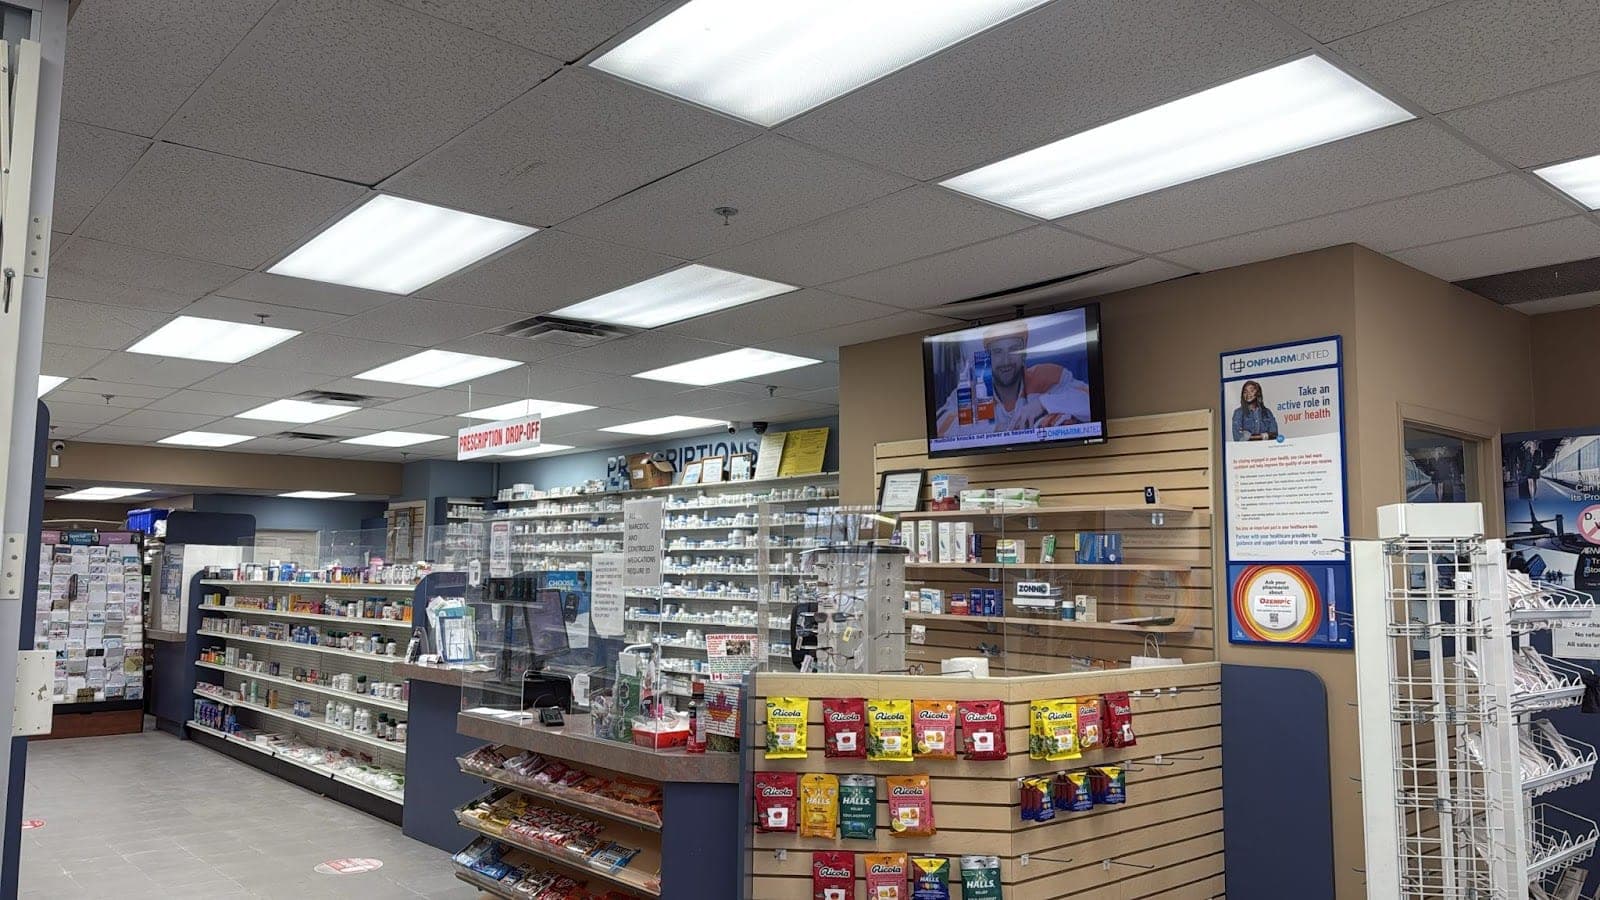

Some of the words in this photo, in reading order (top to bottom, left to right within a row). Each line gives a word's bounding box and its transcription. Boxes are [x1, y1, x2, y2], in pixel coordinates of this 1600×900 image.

[1246, 349, 1330, 368] ONPHARMUNITED
[1298, 386, 1317, 397] Take
[1319, 386, 1330, 394] an
[1277, 401, 1301, 411] active
[1303, 398, 1320, 408] role
[1322, 397, 1330, 406] in
[1284, 413, 1302, 424] your
[1304, 408, 1331, 420] health
[460, 428, 504, 452] PRESCRIPTION
[506, 421, 540, 445] DROP-OFF
[1576, 483, 1595, 493] Can
[629, 522, 650, 530] NARCOTIC
[772, 708, 801, 718] Ricola
[830, 712, 860, 722] Ricola
[875, 712, 905, 721] Ricola
[919, 710, 949, 720] Ricola
[966, 713, 996, 721] Ricola
[1048, 713, 1073, 721] Ricola
[762, 787, 793, 796] Ricola
[893, 787, 923, 796] Ricola
[806, 797, 830, 805] HALLS
[842, 797, 870, 805] HALLS
[819, 867, 850, 878] Ricola
[871, 864, 902, 874] Ricola
[966, 879, 996, 889] HALLS
